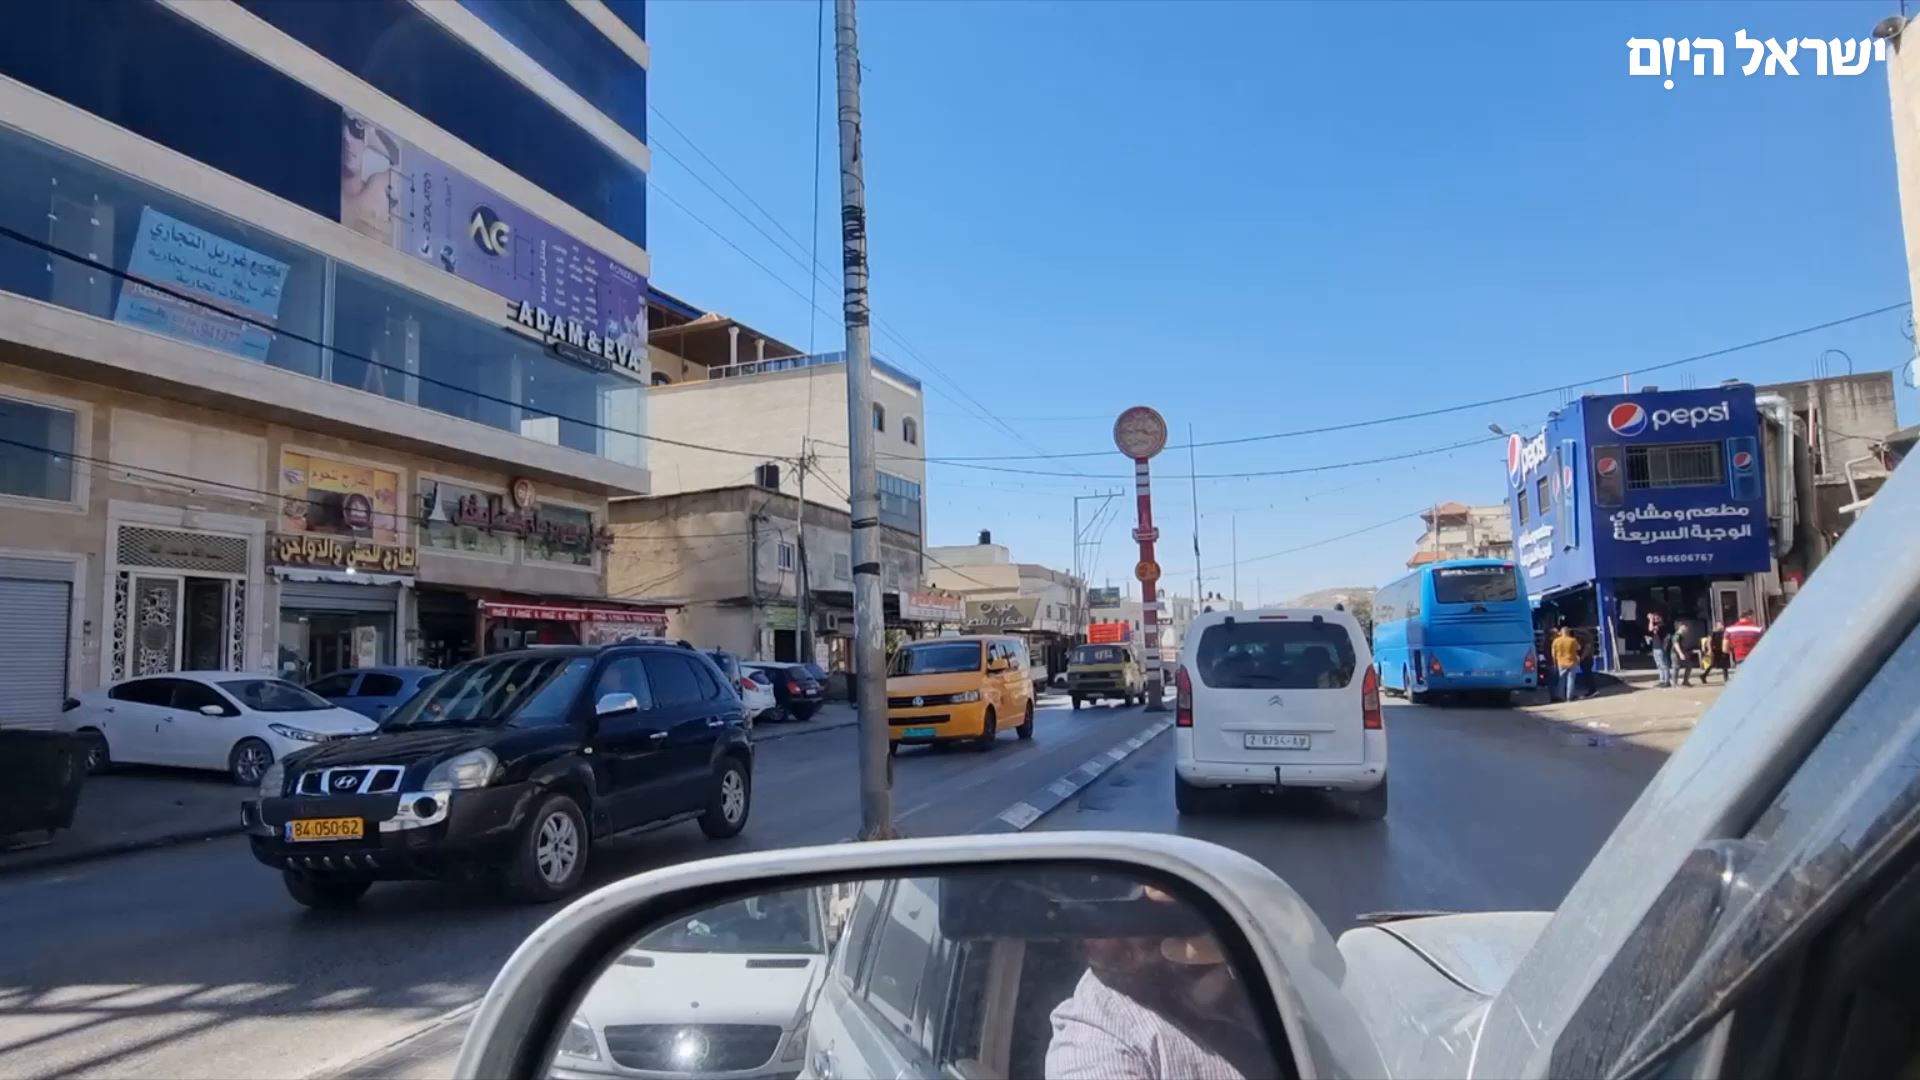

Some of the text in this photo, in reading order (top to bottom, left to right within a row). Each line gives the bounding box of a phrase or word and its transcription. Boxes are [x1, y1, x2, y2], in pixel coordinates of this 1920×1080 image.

[150, 222, 205, 251] التجاري
[1652, 401, 1730, 430] pepsi
[1686, 503, 1750, 520] مطعم
[1613, 523, 1752, 544] الوجبة السريعة
